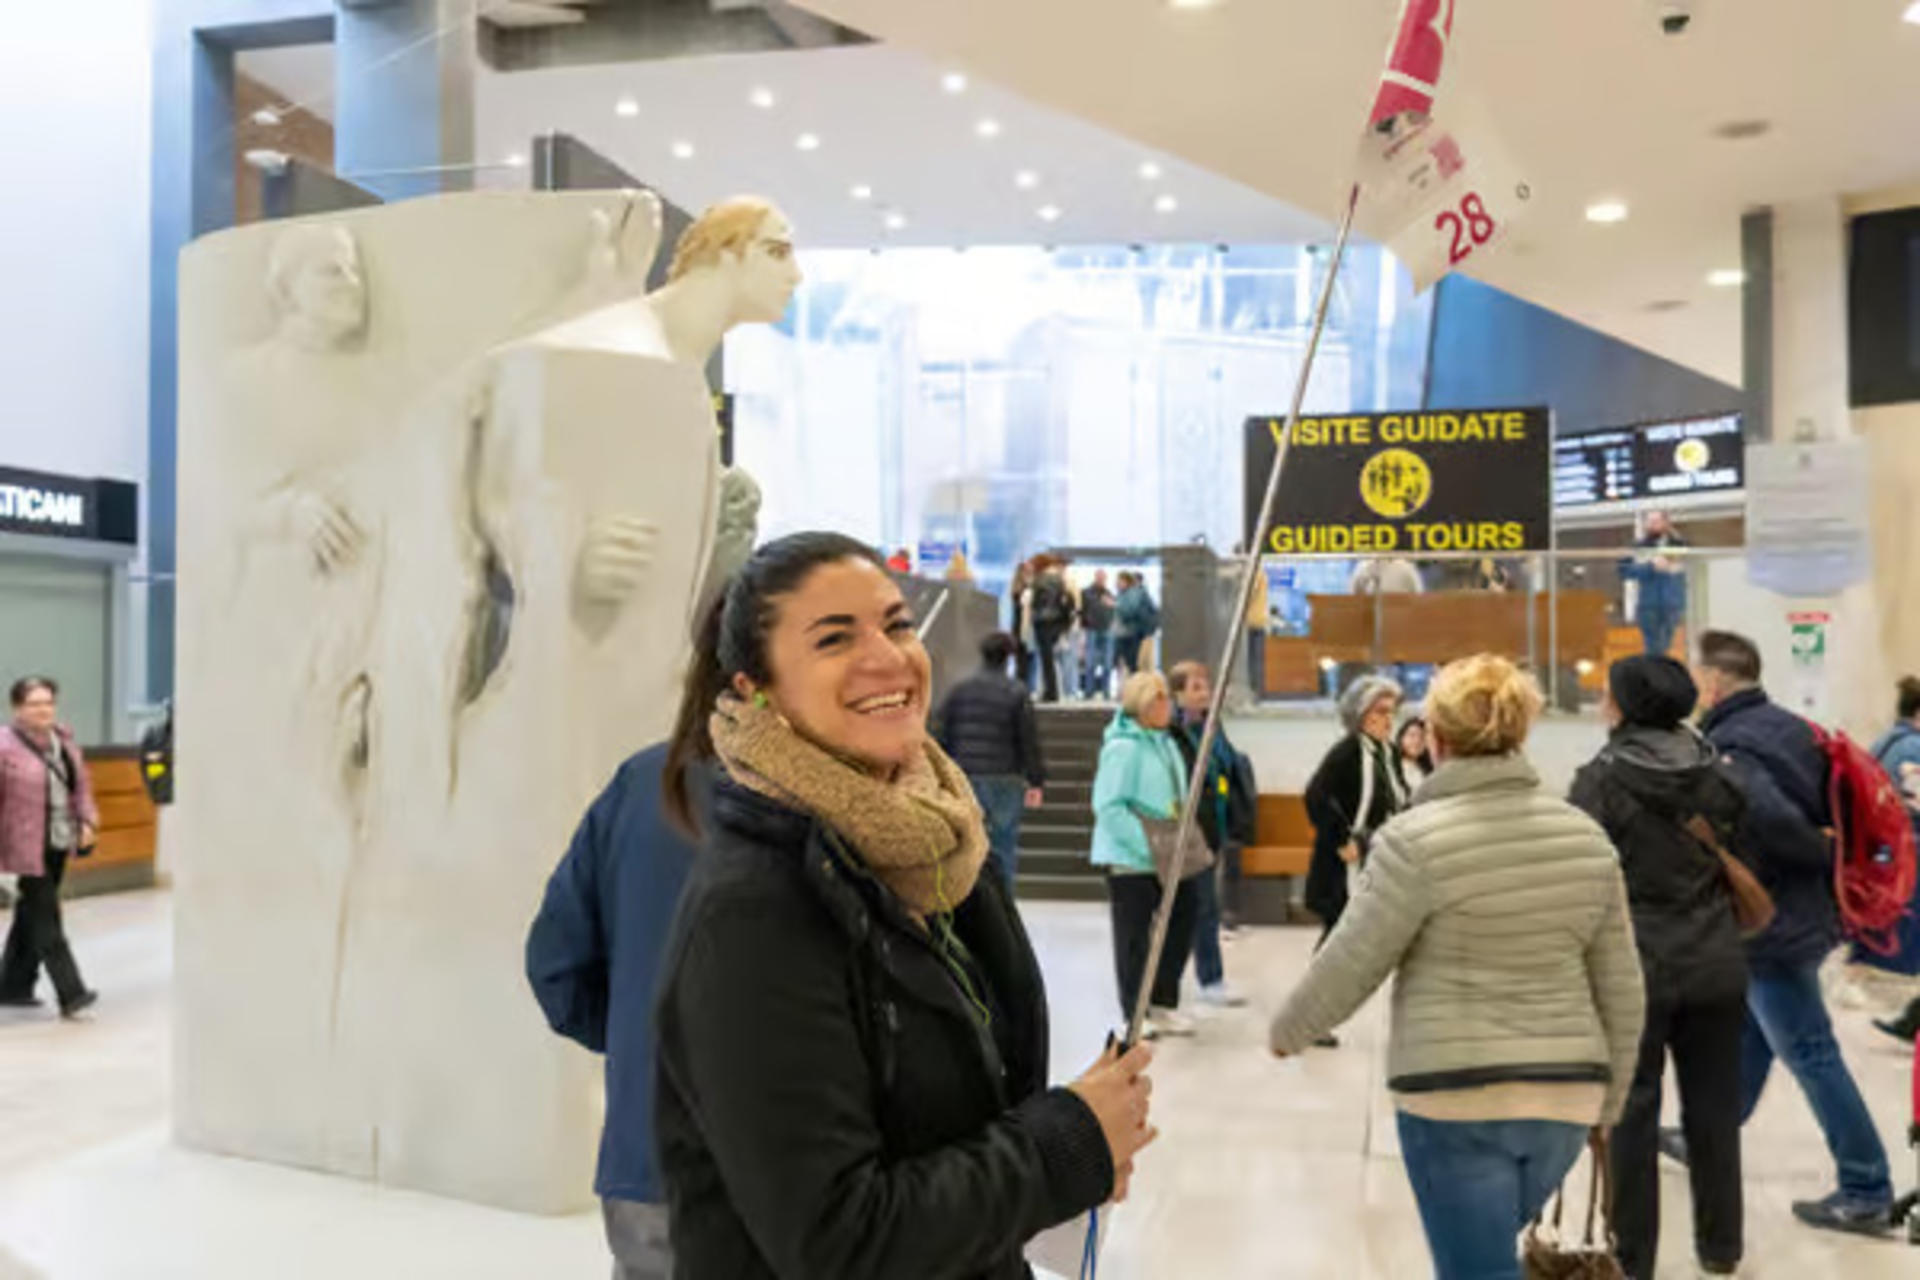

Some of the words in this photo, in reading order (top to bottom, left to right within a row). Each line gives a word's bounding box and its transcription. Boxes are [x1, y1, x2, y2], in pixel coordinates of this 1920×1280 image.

[1434, 191, 1495, 265] 28
[1379, 411, 1526, 443] GUIDATE
[0, 484, 84, 526] TICANI
[1269, 522, 1397, 552] GUIDED
[1404, 522, 1524, 549] TOURS
